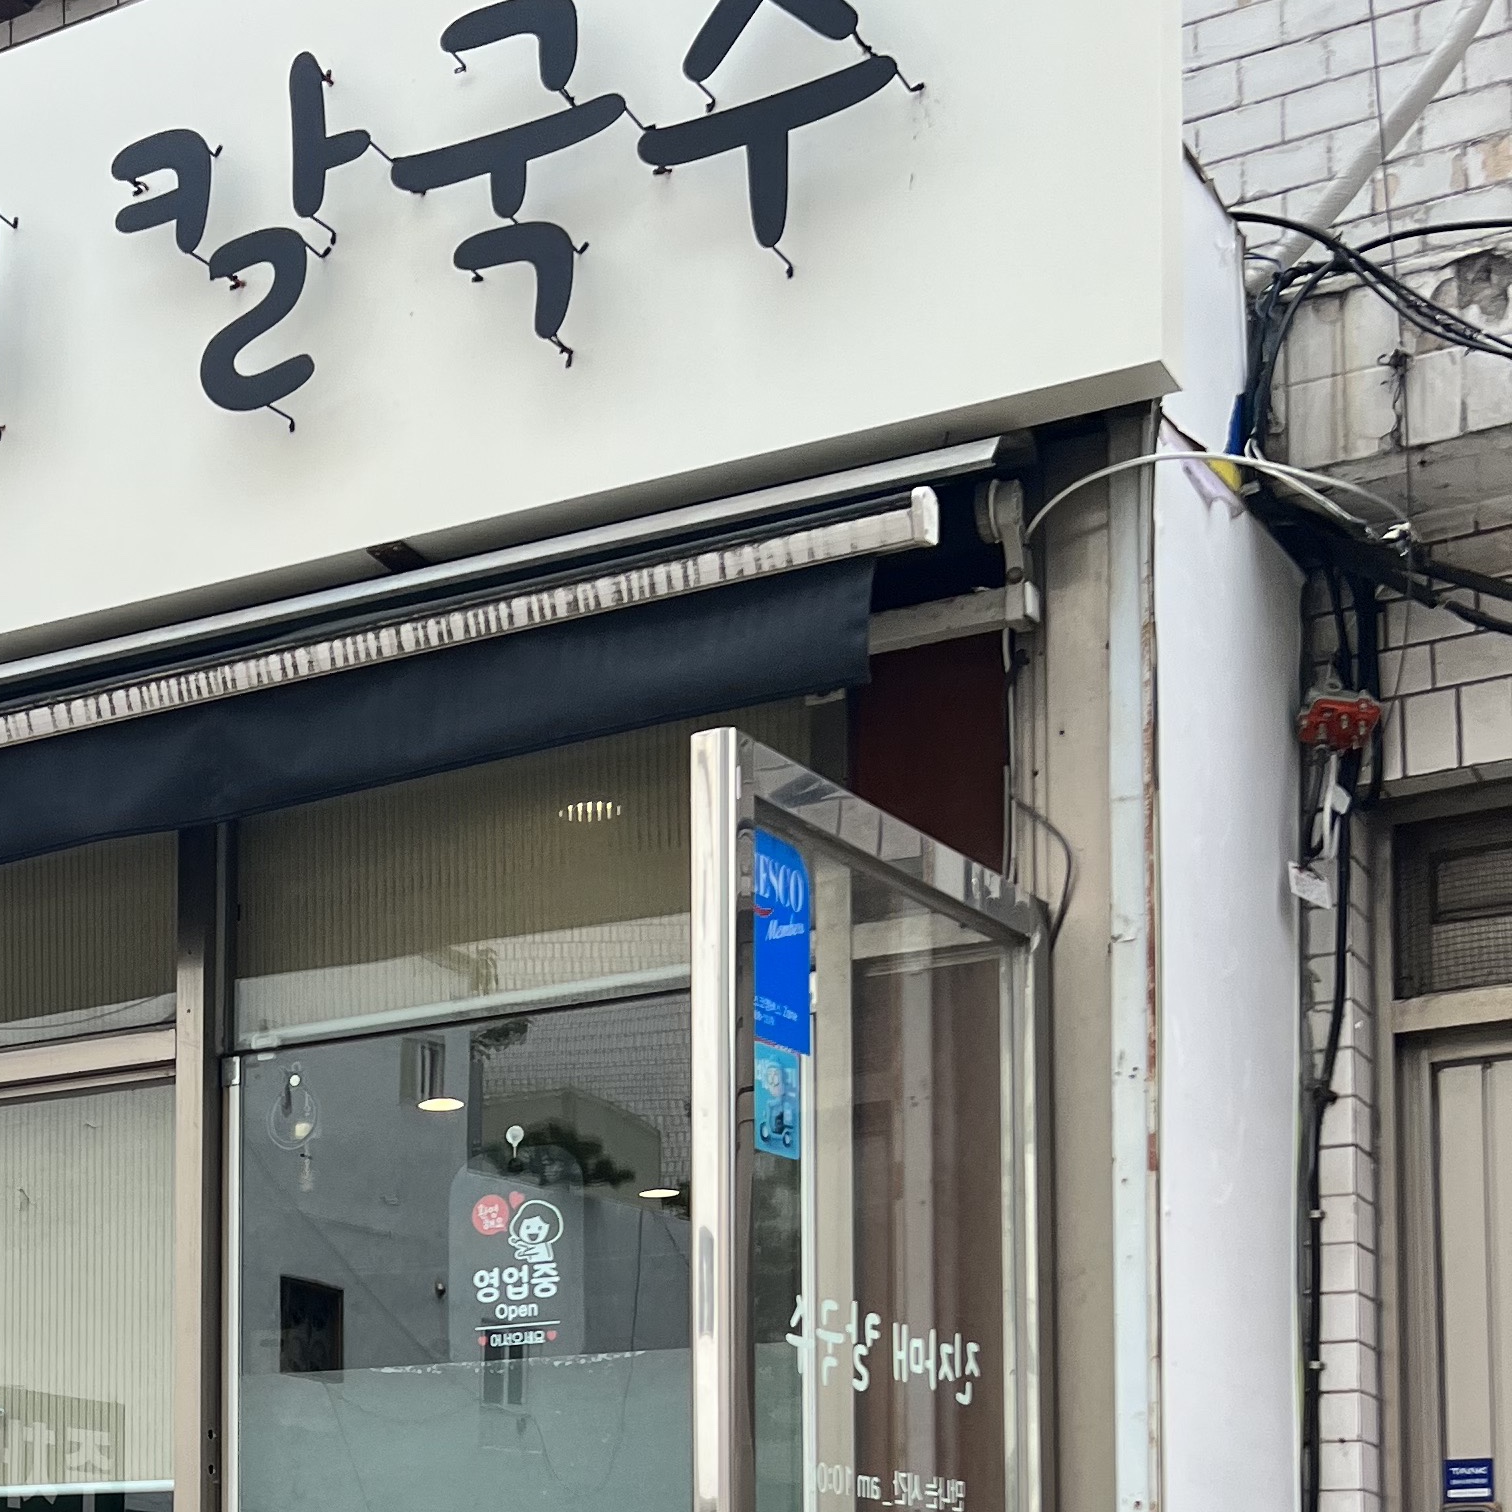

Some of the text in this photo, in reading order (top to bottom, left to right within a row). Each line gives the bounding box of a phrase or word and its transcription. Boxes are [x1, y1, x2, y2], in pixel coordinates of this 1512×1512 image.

[111, 0, 898, 412] 칼국수
[472, 1262, 561, 1303] 영업중
[494, 1303, 539, 1321] Open
[489, 1330, 547, 1348] 어서오세요
